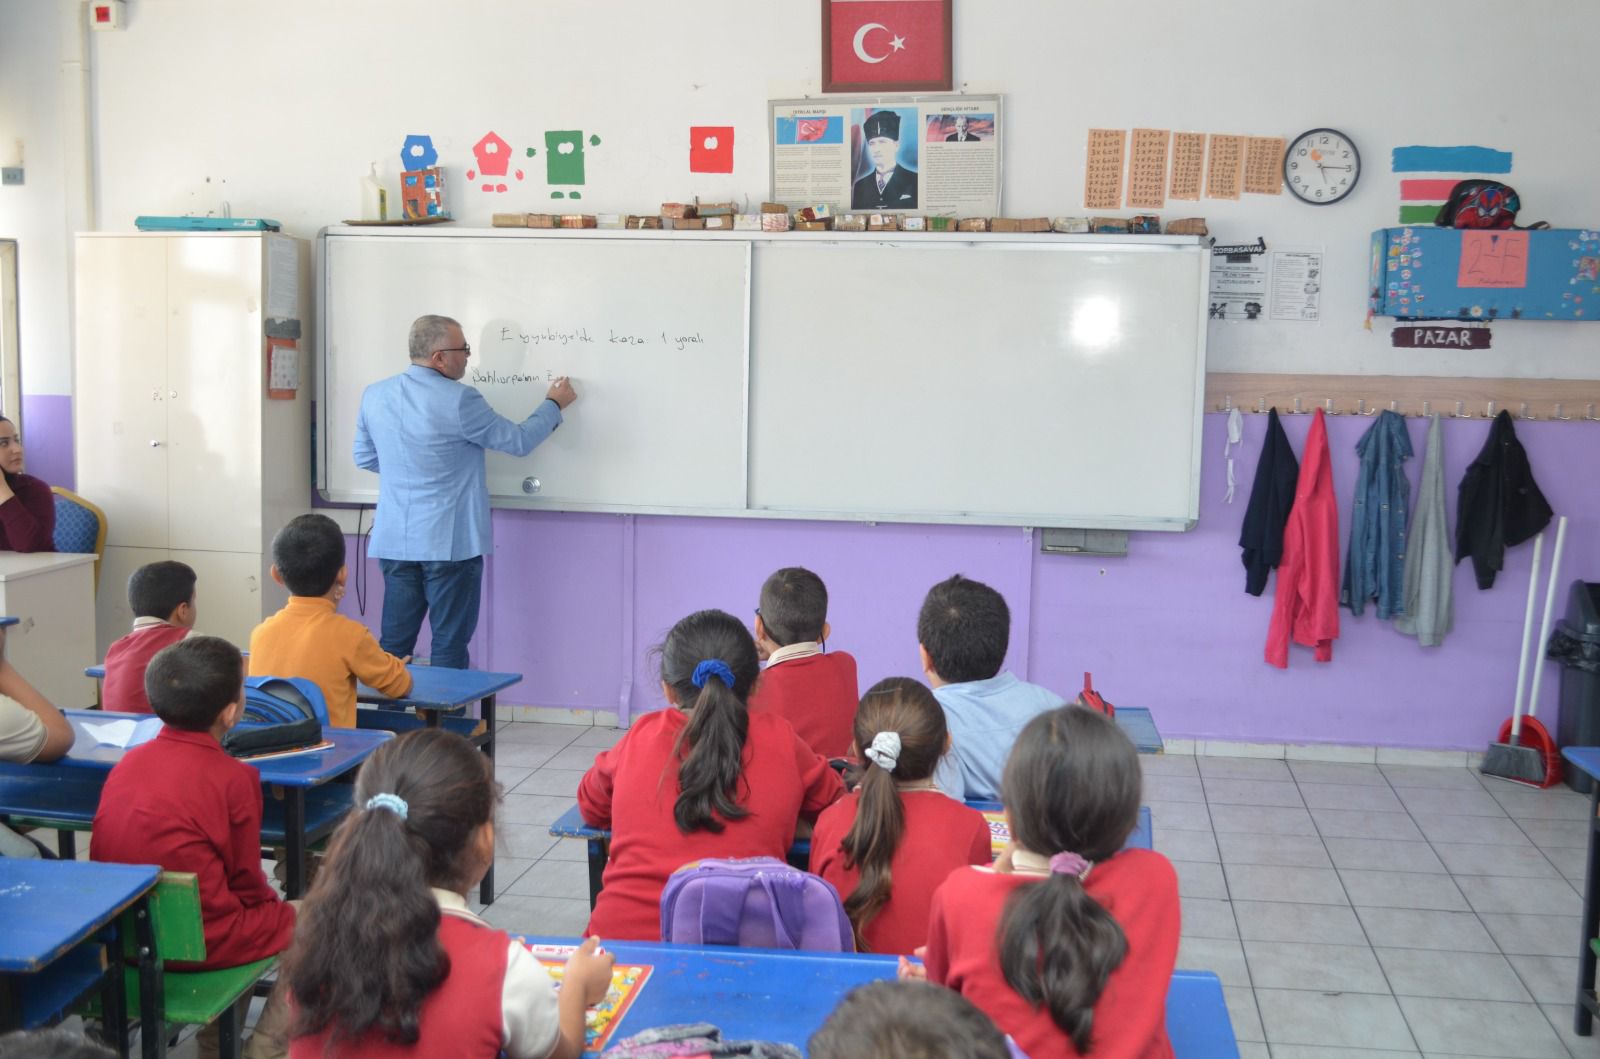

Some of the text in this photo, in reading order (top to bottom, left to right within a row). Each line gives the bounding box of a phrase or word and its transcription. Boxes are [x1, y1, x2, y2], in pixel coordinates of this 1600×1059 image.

[1320, 136, 1329, 144] 12
[1336, 141, 1340, 149] 1
[1297, 148, 1307, 156] 10
[1342, 150, 1349, 158] 2
[1291, 162, 1298, 170] 9
[1345, 164, 1352, 172] 3
[1302, 185, 1309, 193] 7
[1315, 189, 1322, 197] 6
[1330, 186, 1337, 194] 5
[662, 331, 667, 344] 1
[1413, 328, 1472, 347] PAZAR
